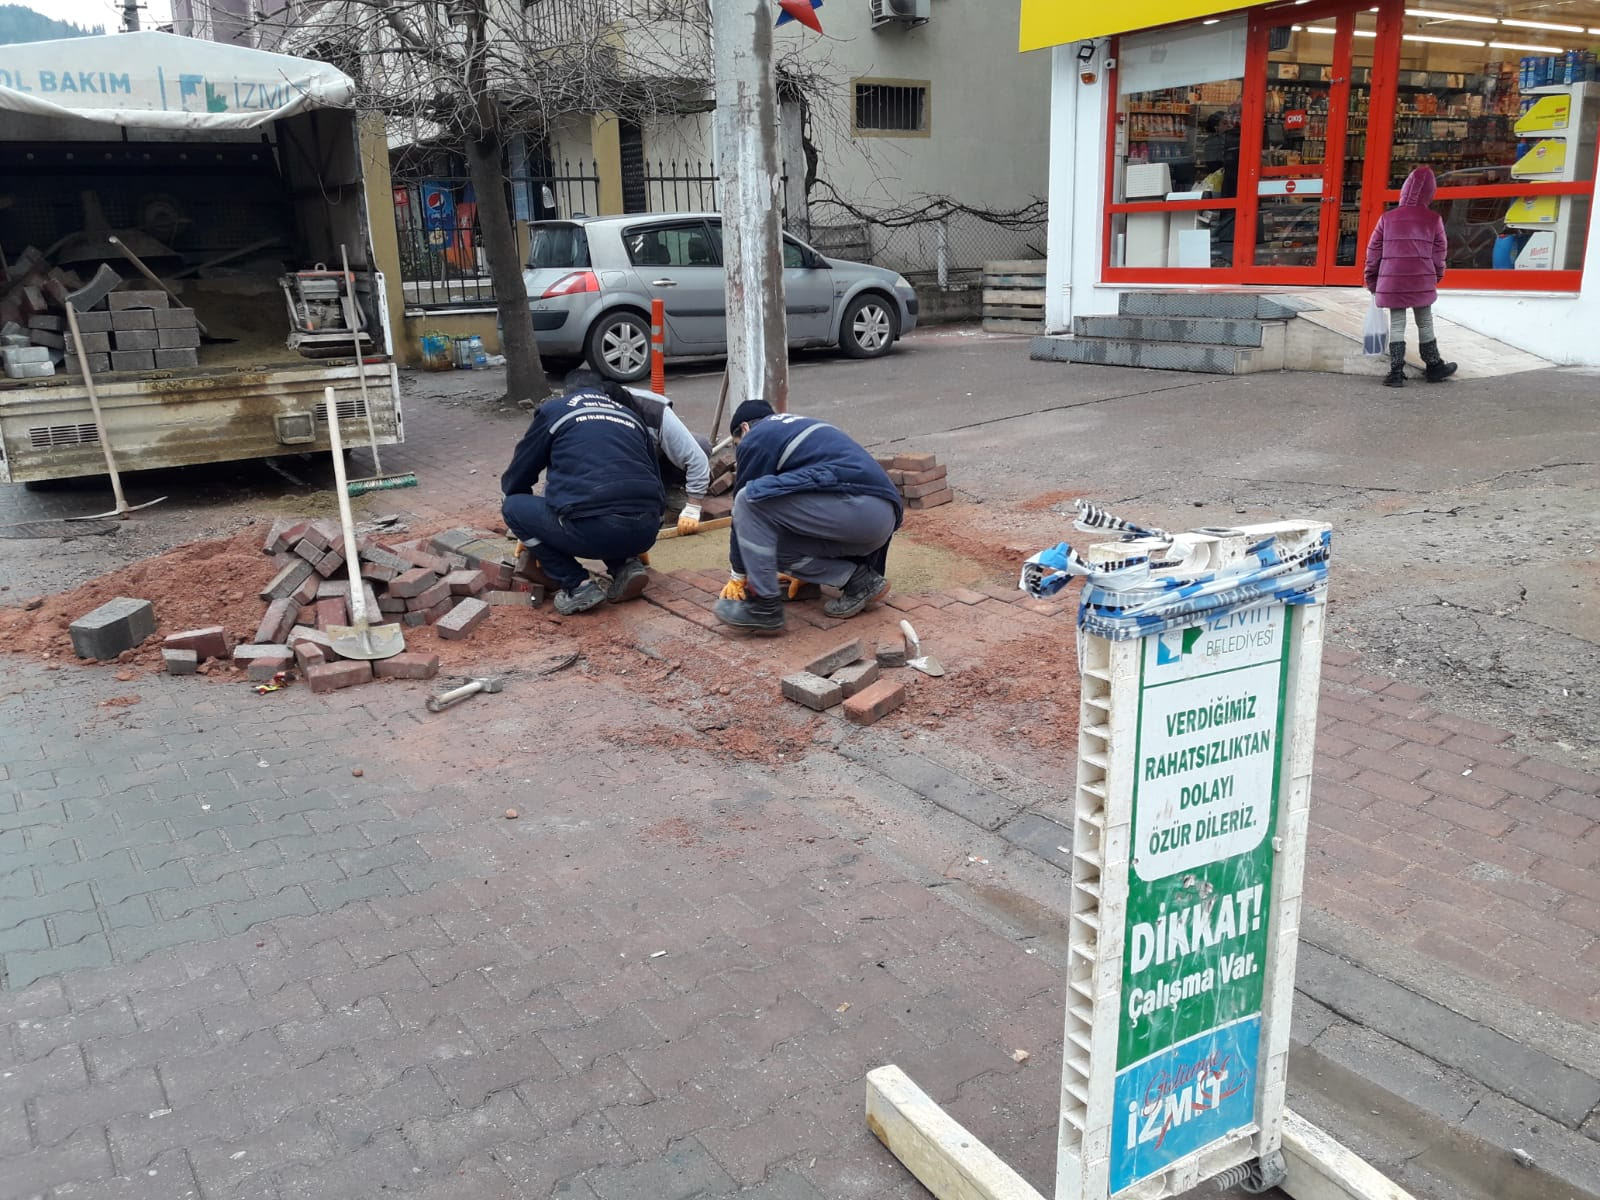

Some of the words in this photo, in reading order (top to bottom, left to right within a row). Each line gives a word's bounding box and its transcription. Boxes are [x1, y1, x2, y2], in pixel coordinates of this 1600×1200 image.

[39, 70, 131, 93] BAKIM
[1205, 628, 1274, 657] BELEDİYESİ
[1166, 691, 1257, 737] VERDİĞİMİZ
[1144, 729, 1271, 781] RAHATSIZLIKTAN
[1180, 775, 1234, 810] DOLAYI
[1149, 825, 1192, 855] ÖZÜR
[1195, 802, 1257, 844] DİLERİZ.
[1130, 884, 1264, 975] DİKKAT!
[1128, 967, 1214, 1028] Çalışma
[1221, 951, 1258, 985] Var.
[1127, 1070, 1229, 1150] İZMİT
